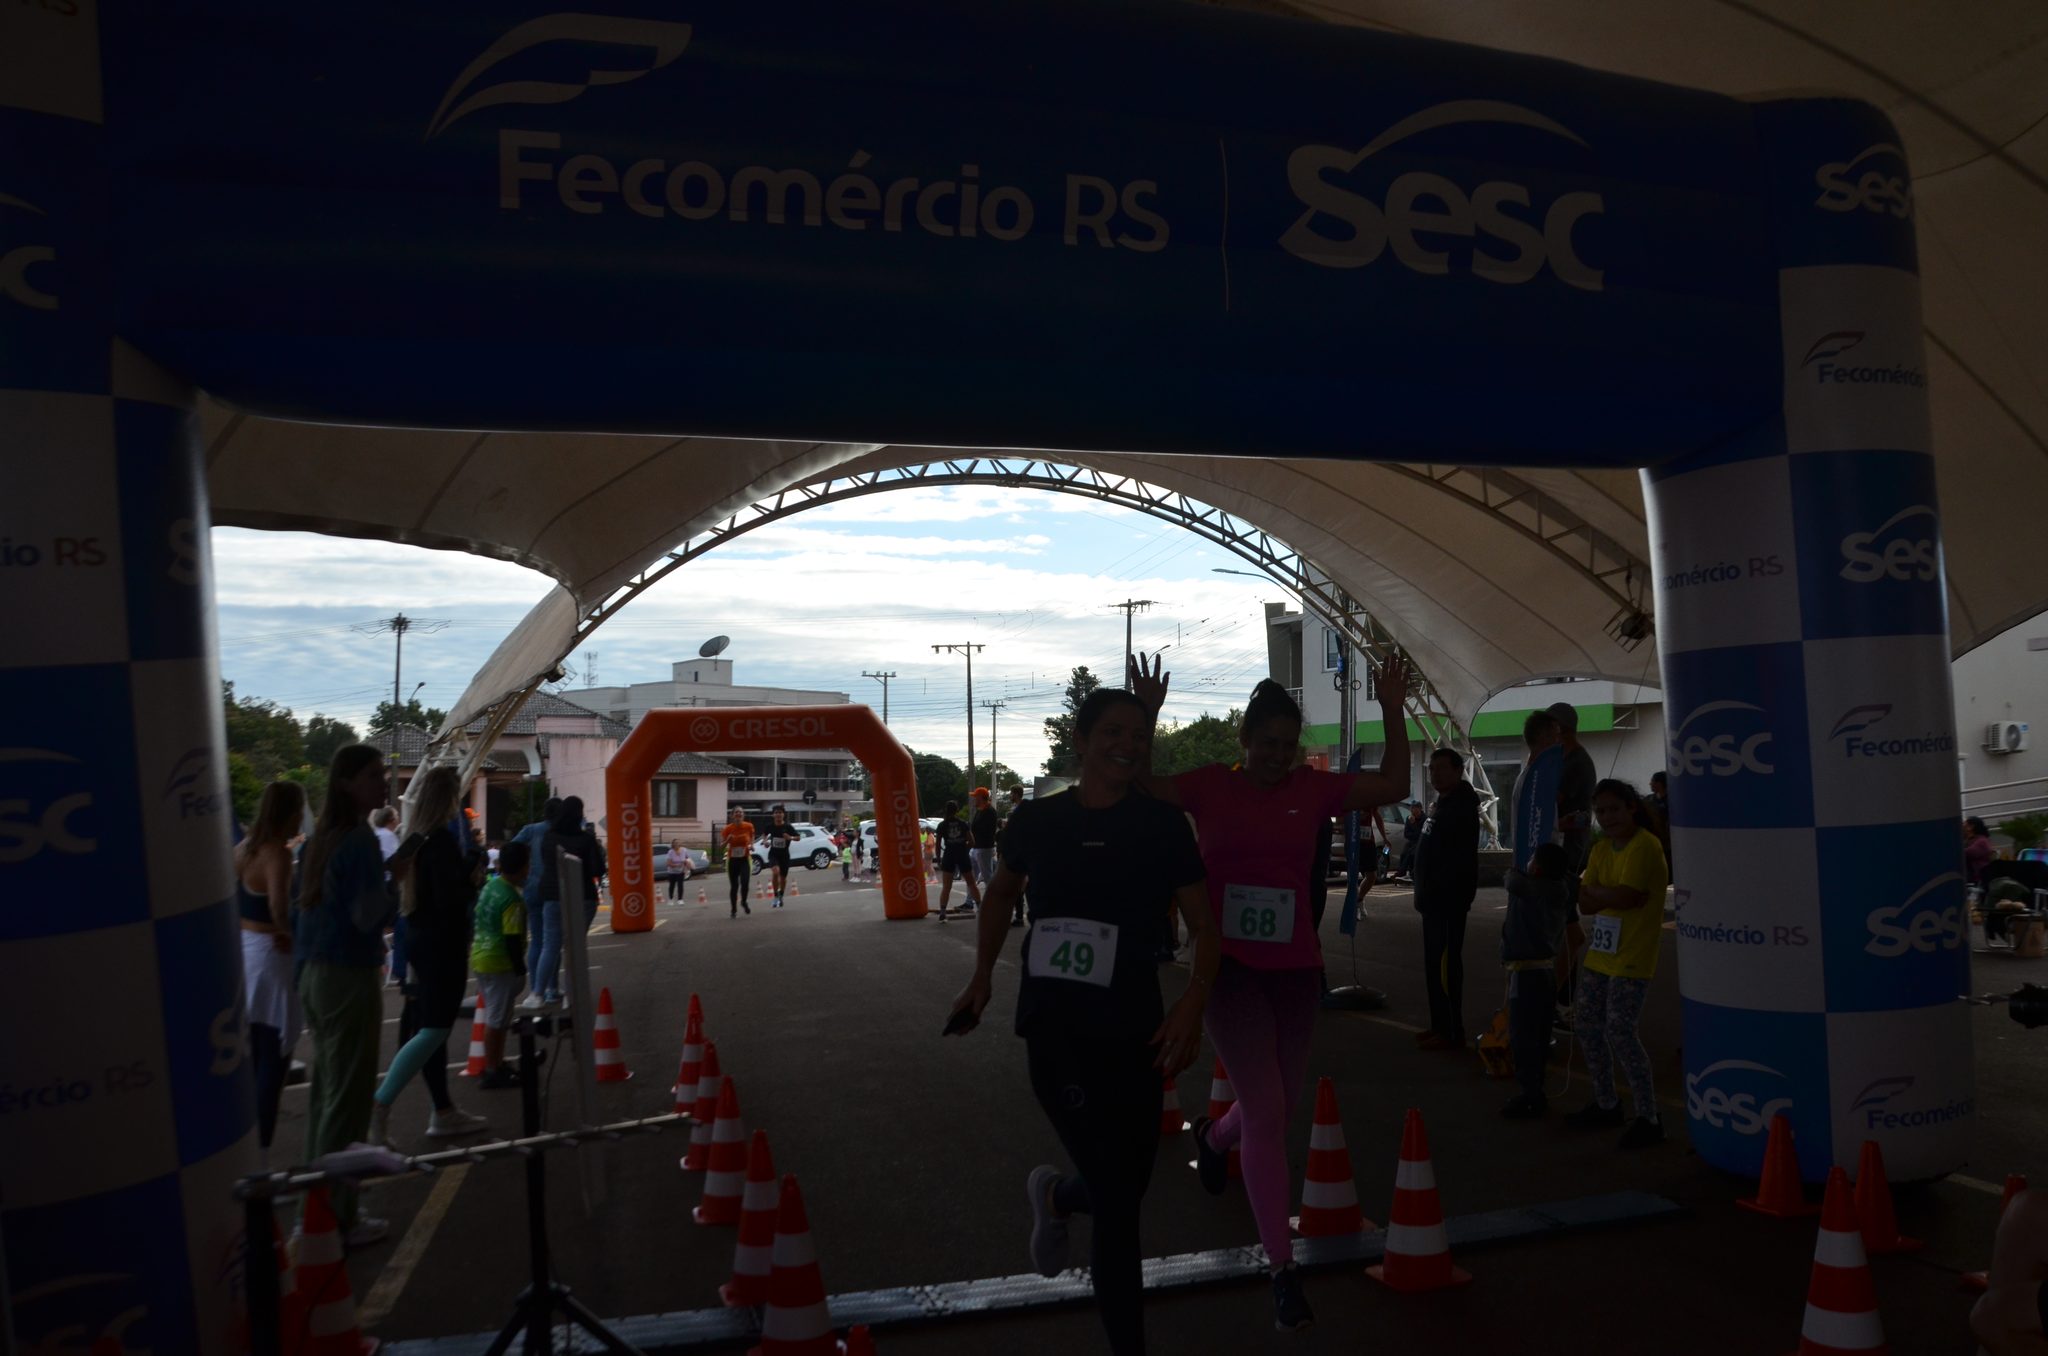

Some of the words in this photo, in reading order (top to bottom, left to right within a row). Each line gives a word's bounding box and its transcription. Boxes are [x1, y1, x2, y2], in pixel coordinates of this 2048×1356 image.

[499, 128, 1034, 241] Fecomércio
[1063, 173, 1171, 253] RS
[1814, 161, 1913, 220] Ses
[1277, 144, 1606, 293] Sesc
[54, 536, 107, 566] RS
[1748, 555, 1784, 578] RS
[729, 716, 834, 739] CRESOL
[621, 795, 641, 886] CRESOL
[893, 783, 916, 870] CRESOL
[1240, 906, 1276, 937] 68
[1677, 916, 1765, 945] ecomércio
[1773, 926, 1809, 946] RS
[1864, 905, 1967, 958] Ses
[1049, 940, 1094, 976] 49
[104, 1058, 155, 1096] RS
